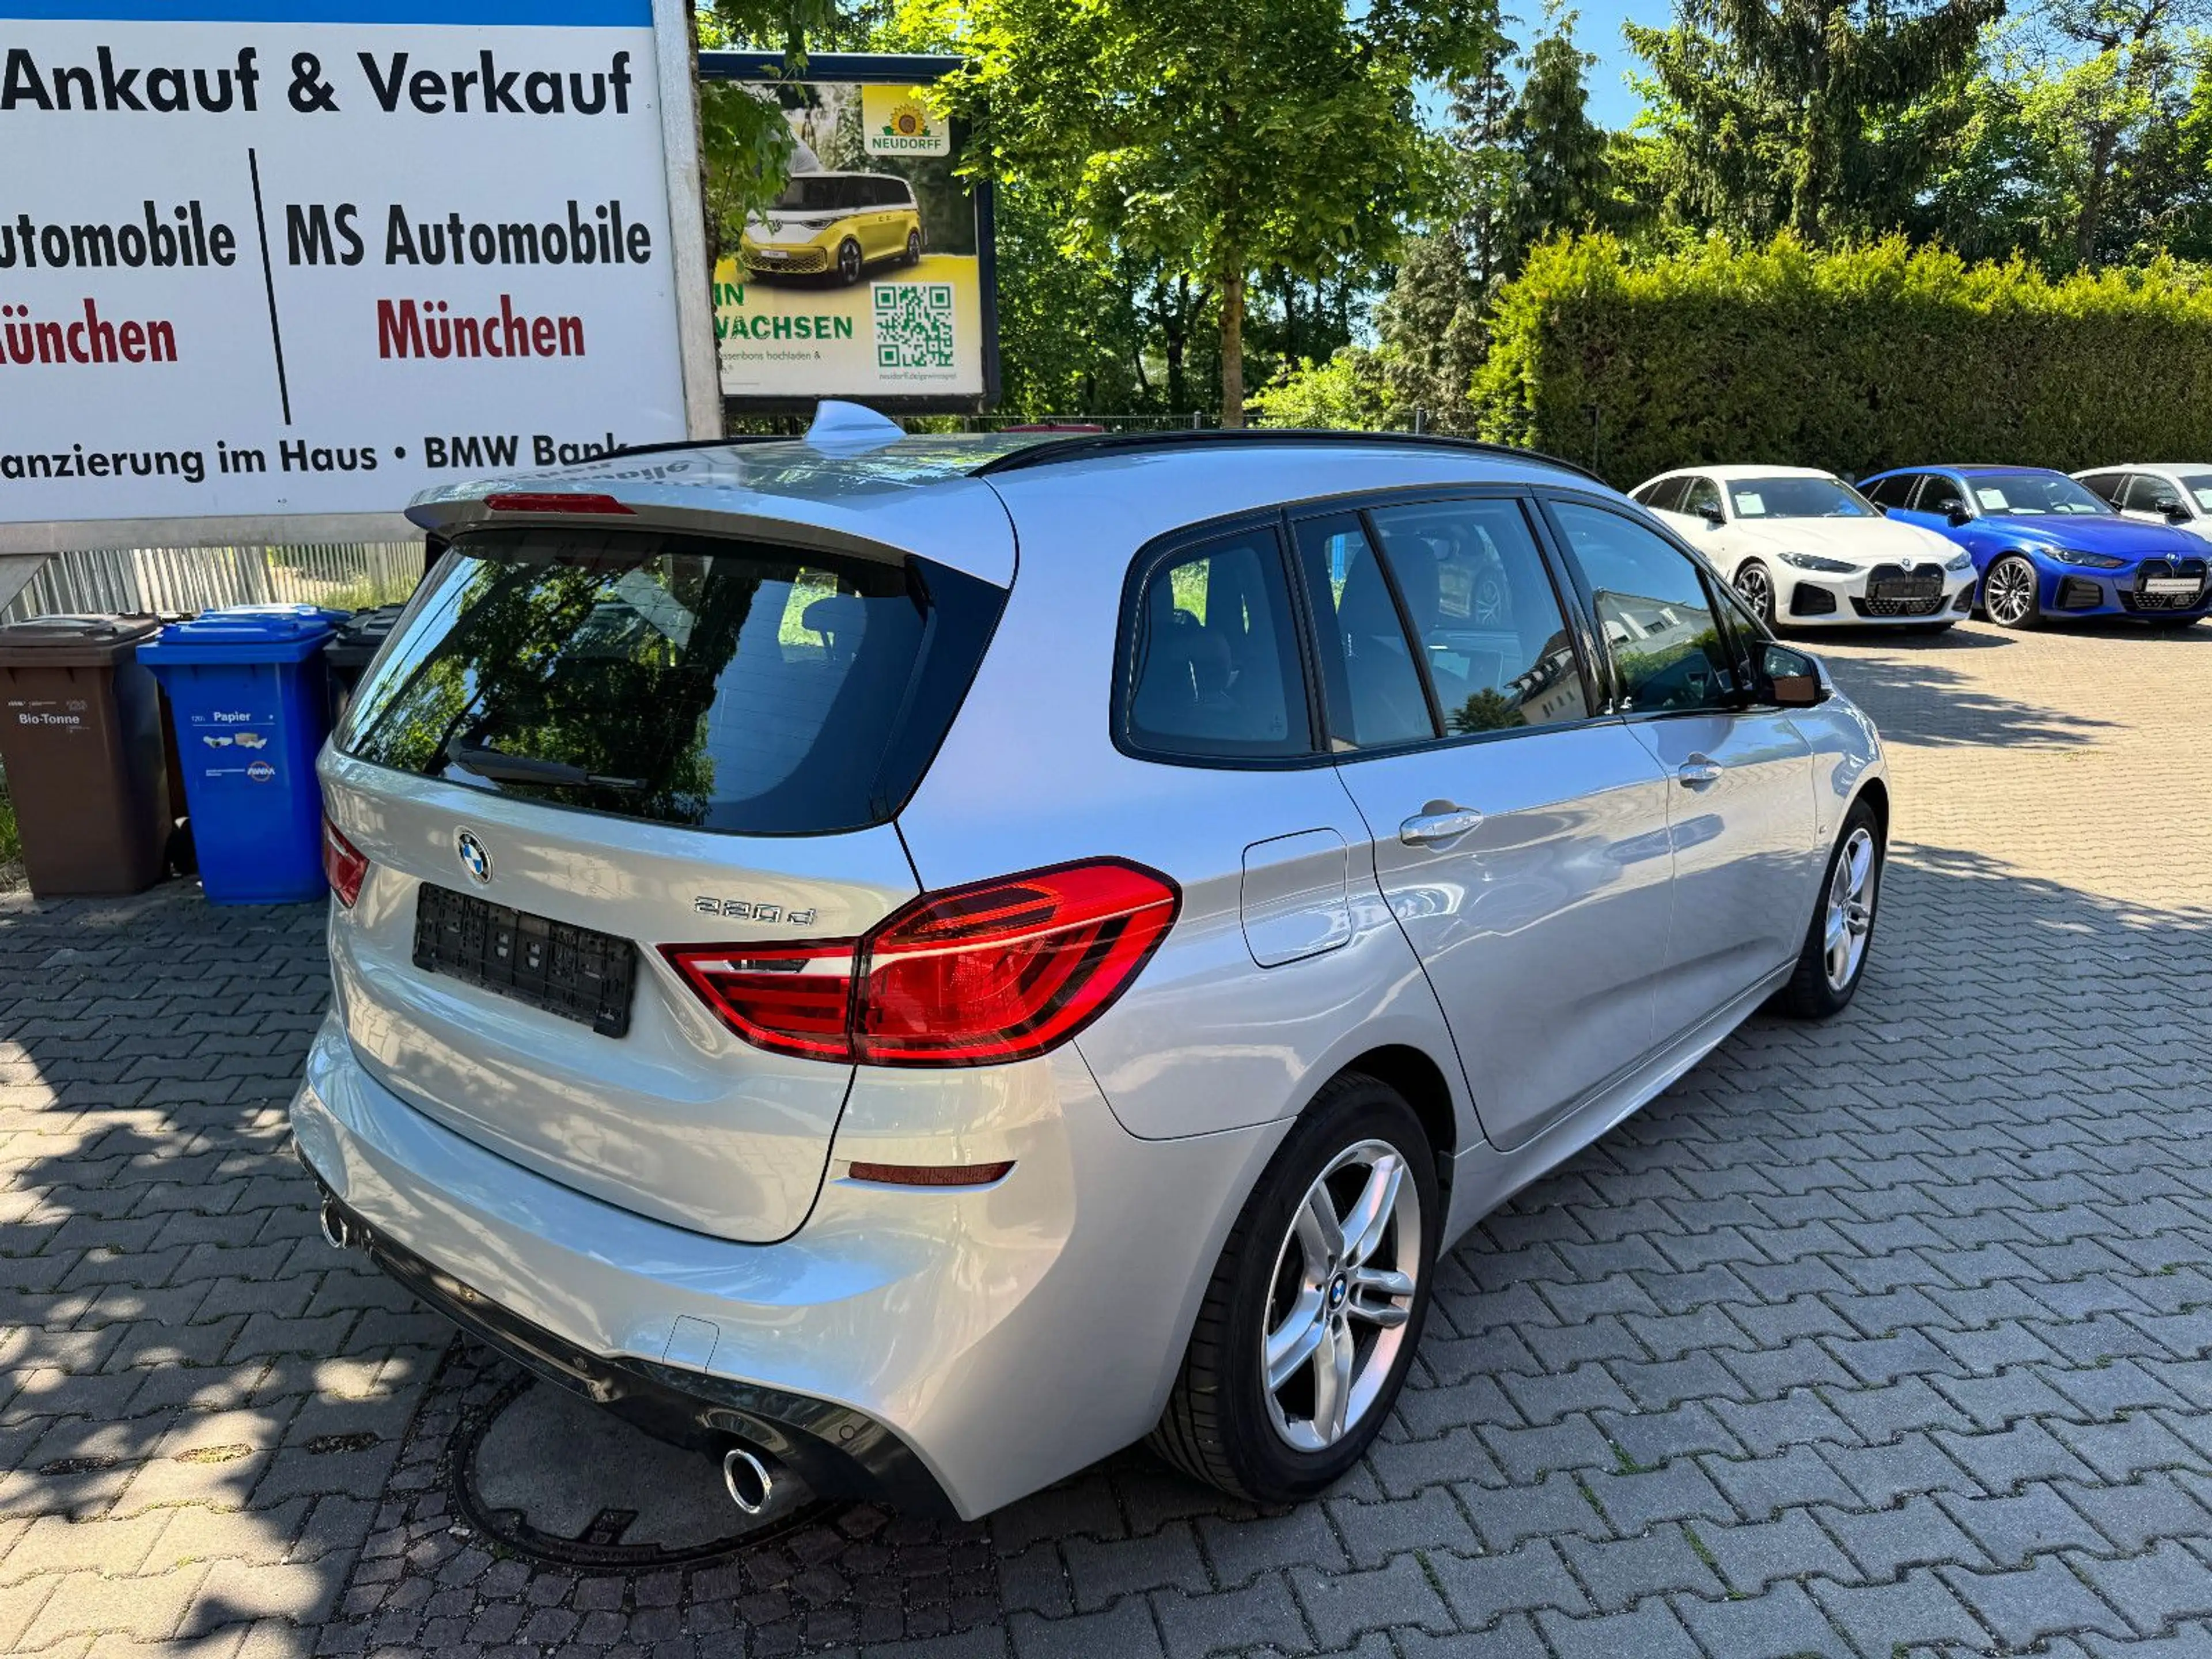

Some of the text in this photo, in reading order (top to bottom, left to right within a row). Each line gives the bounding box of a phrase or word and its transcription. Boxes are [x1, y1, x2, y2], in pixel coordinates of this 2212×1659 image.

[0, 46, 631, 115] Ankauf & Verkauf
[872, 138, 941, 150] NEUDORFF
[286, 200, 651, 266] MS Automobile
[0, 298, 178, 365] ünchen
[377, 294, 586, 359] München
[0, 432, 628, 484] anzierung im Haus BMW Bank
[18, 713, 80, 725] Bio-Tonne
[213, 711, 252, 724] Papier
